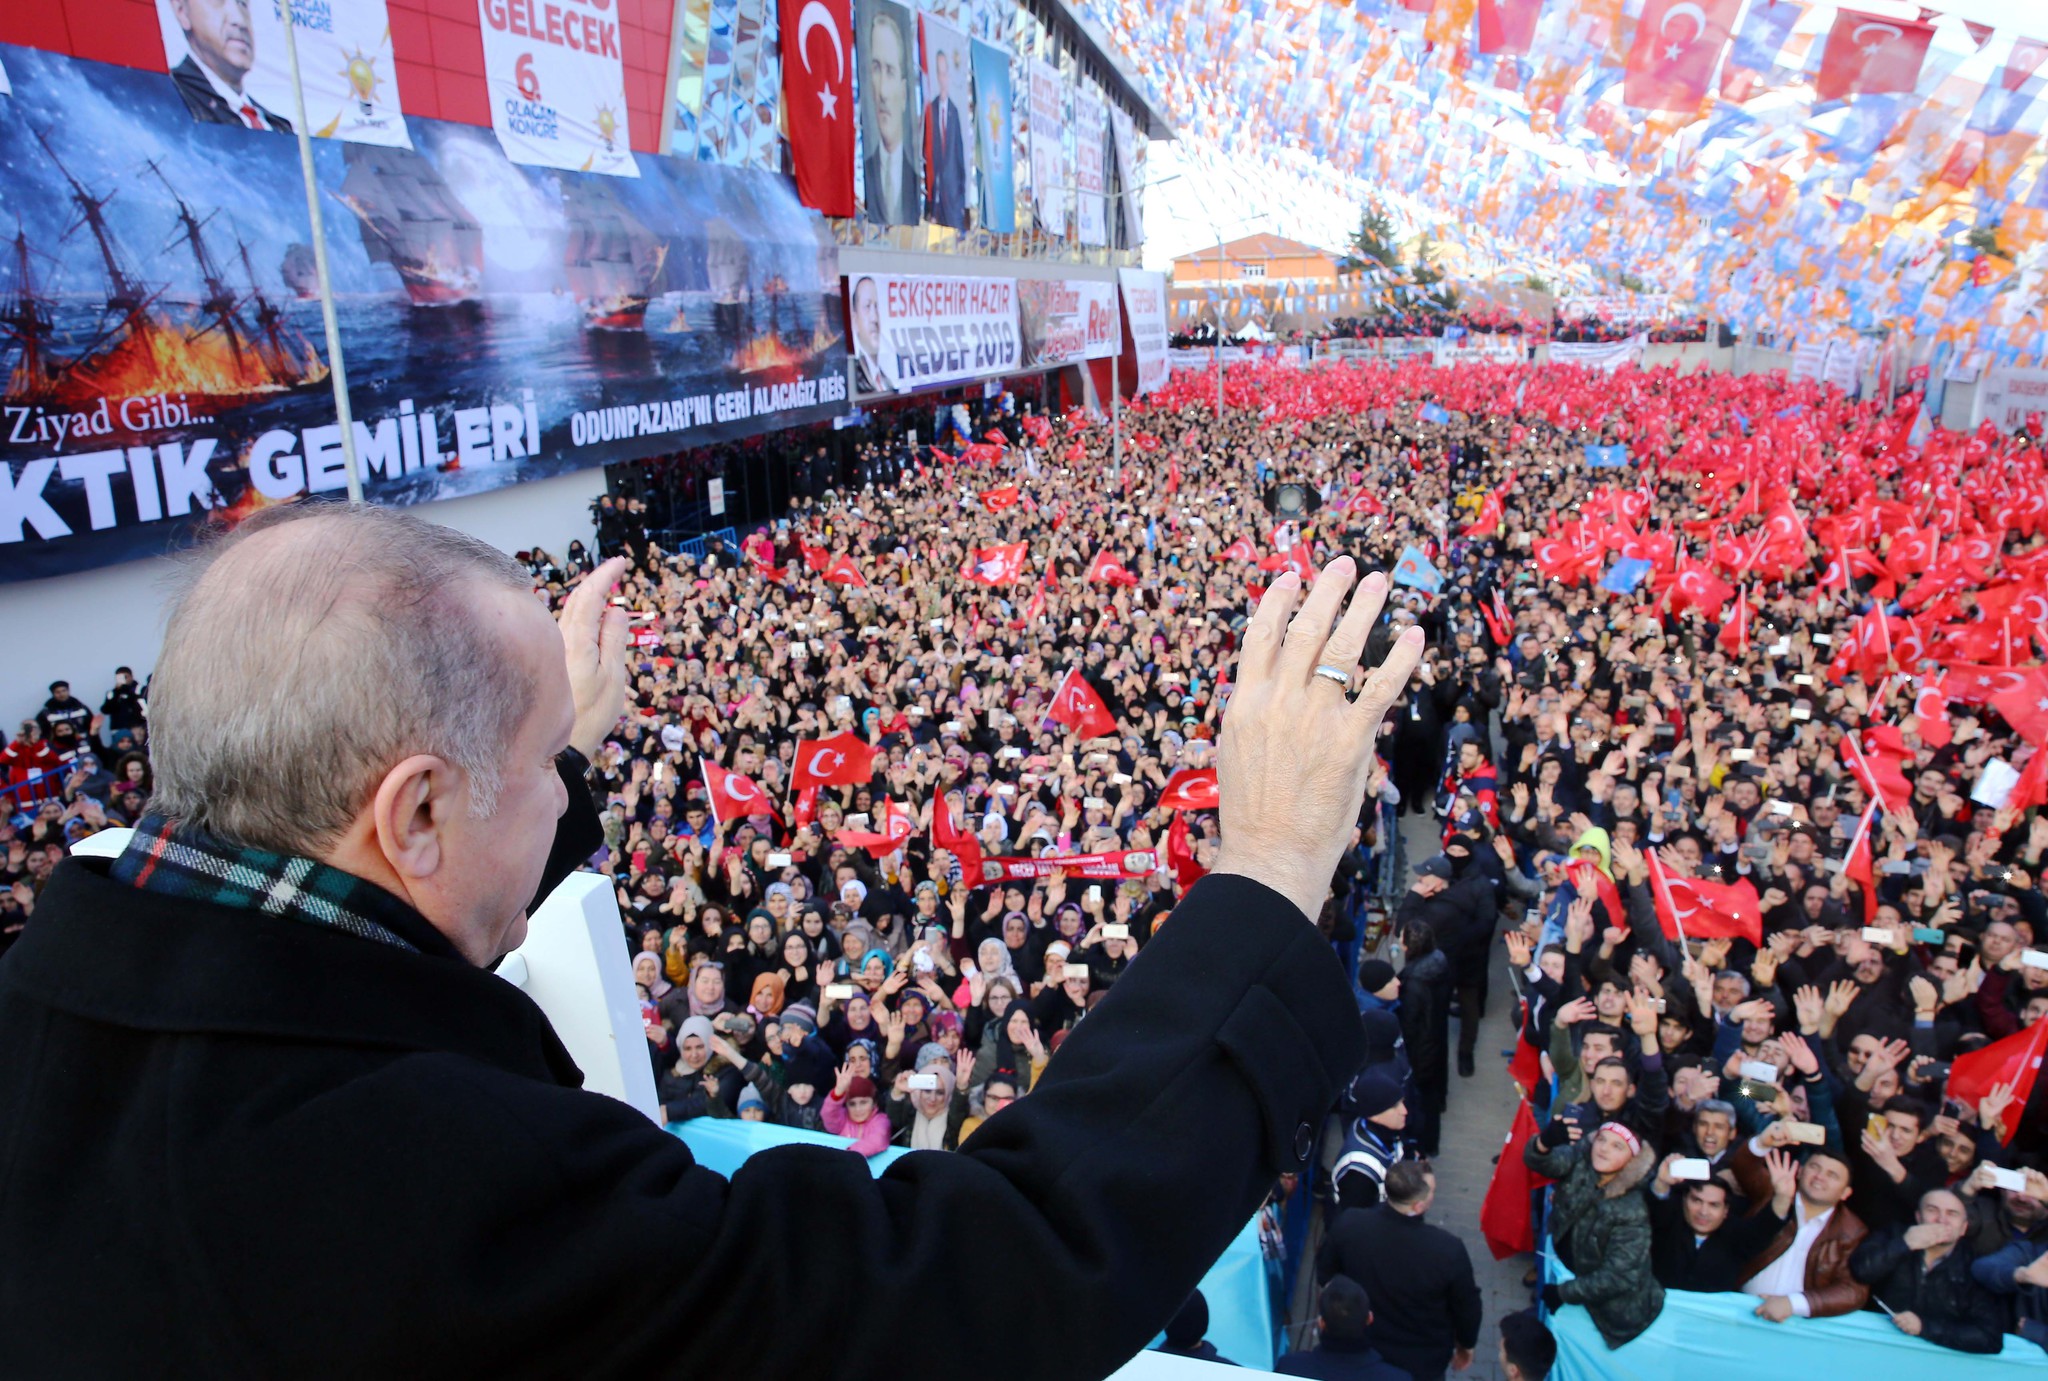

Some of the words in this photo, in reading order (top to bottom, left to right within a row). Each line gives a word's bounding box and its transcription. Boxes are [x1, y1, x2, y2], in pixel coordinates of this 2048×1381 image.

[483, 0, 619, 60] GELECEK
[505, 99, 557, 121] OLAĞAN
[507, 117, 560, 140] KONGRE
[887, 281, 967, 323] ESKİŞEHİR
[970, 282, 1010, 315] HAZIR
[1087, 298, 1118, 342] Rei
[890, 323, 971, 379] HEDEF
[970, 320, 1015, 369] 2019
[4, 397, 113, 452] Ziyad
[120, 394, 215, 432] Gibi...
[571, 393, 713, 447] ODUNPAZARI'NI
[714, 382, 751, 423] GERİ
[753, 374, 817, 416] ALACAĞIZ
[818, 370, 847, 405] REİS
[249, 387, 541, 500] GEMİLERİ
